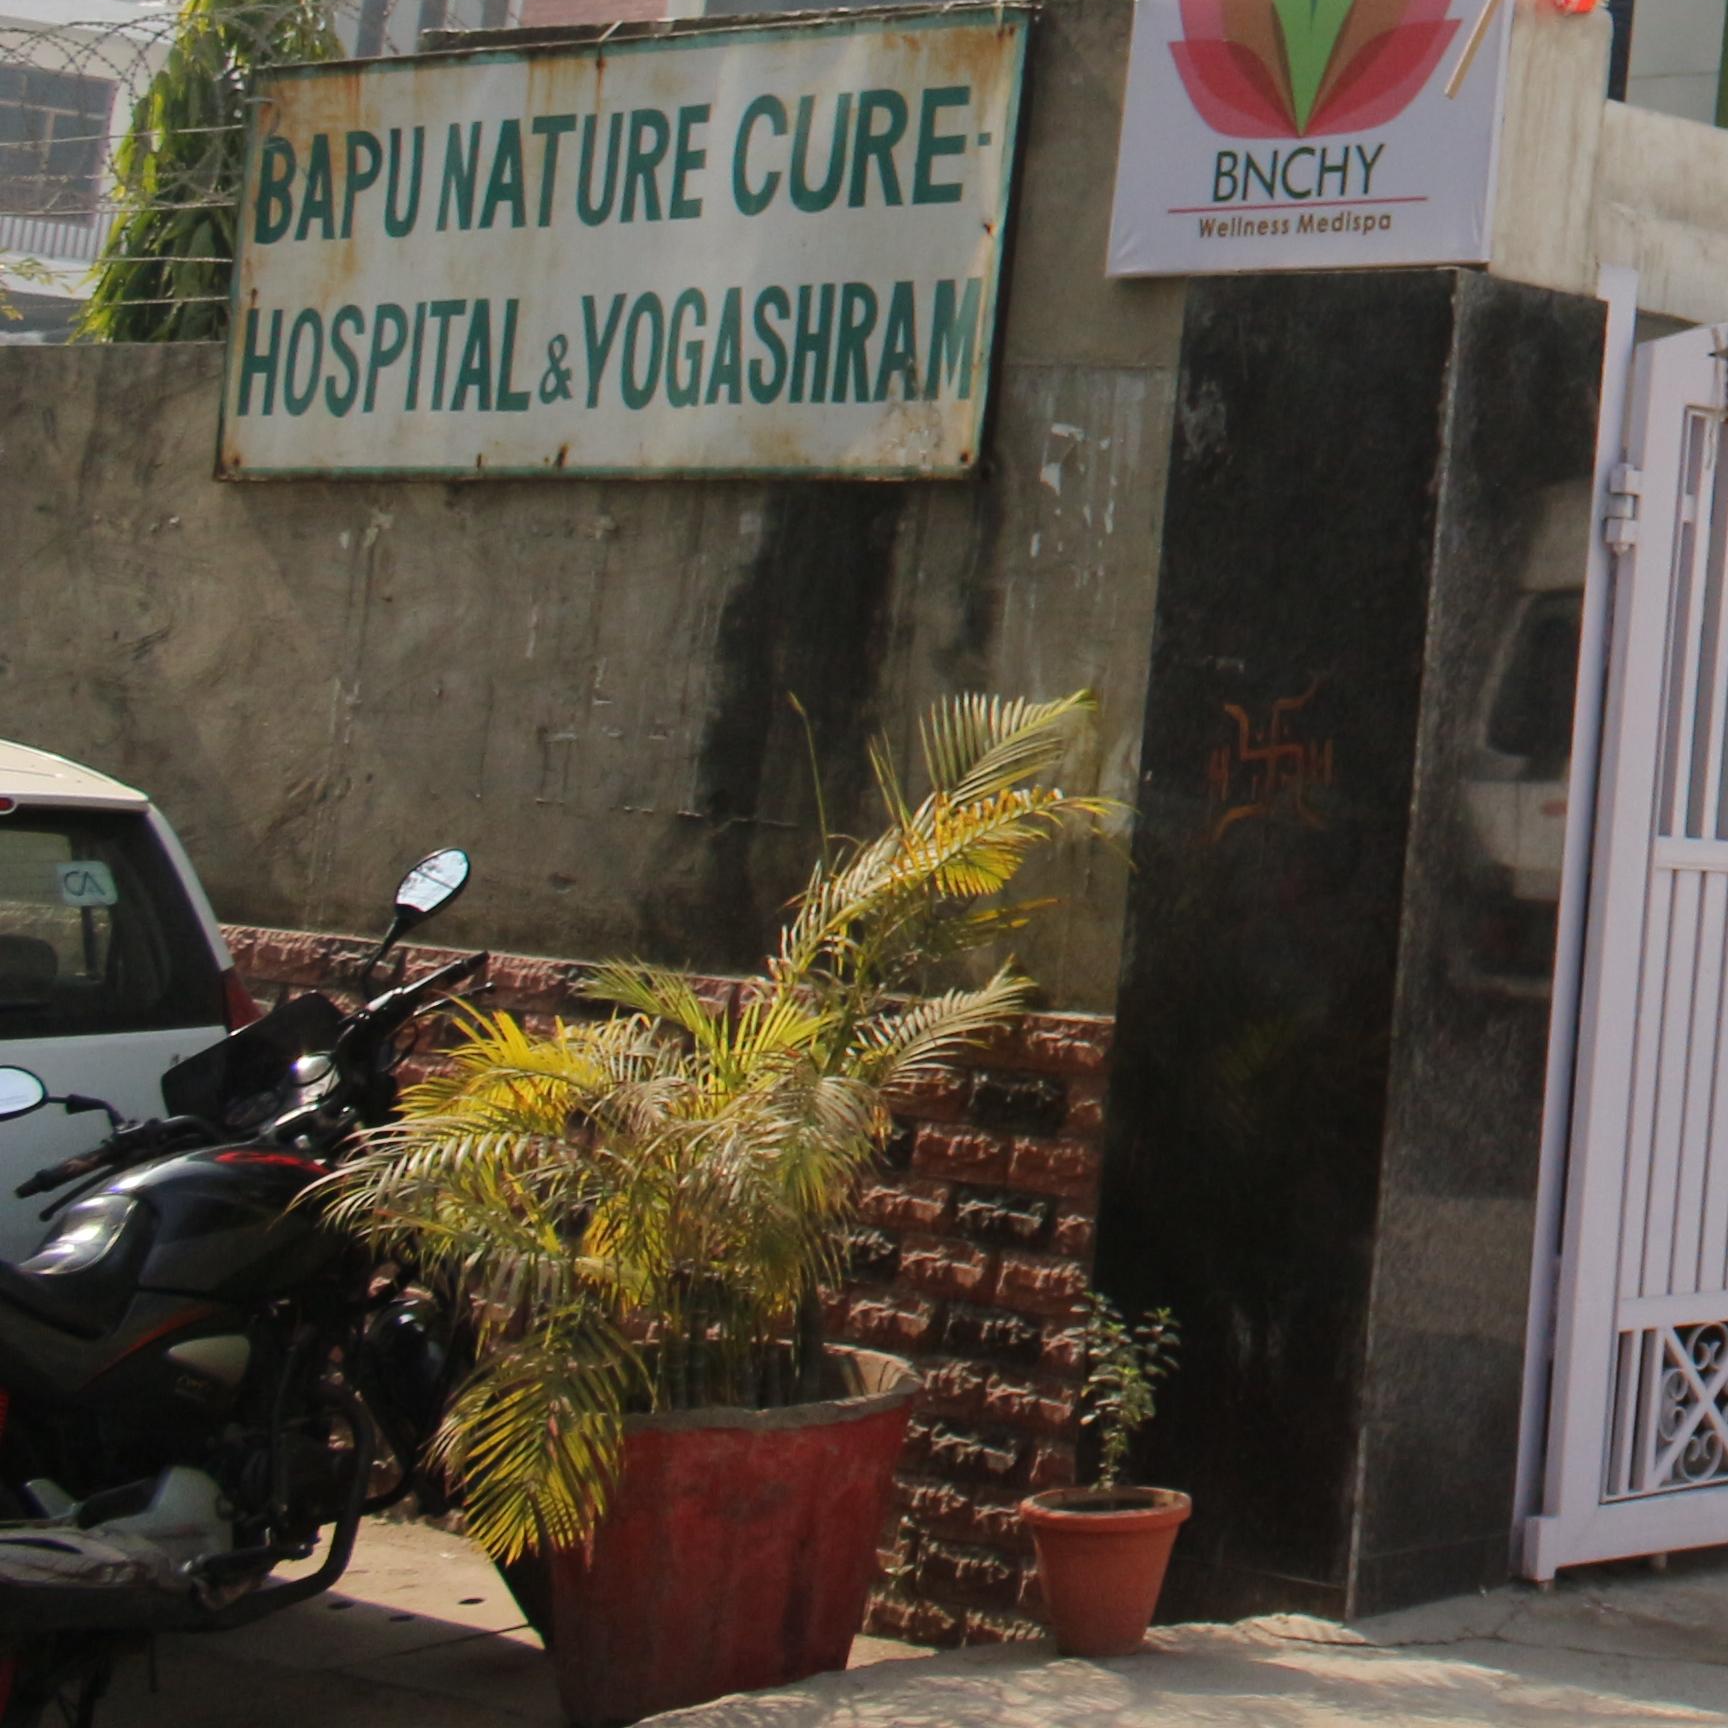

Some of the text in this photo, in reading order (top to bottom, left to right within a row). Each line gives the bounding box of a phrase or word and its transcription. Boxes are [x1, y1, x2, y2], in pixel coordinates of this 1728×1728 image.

[254, 125, 426, 245] BAPU
[436, 102, 712, 232] NATURE
[1212, 143, 1386, 202] BNCHY
[1199, 211, 1393, 239] Wellness Medispa
[236, 277, 983, 418] HOSPITAL & YOGASHRAM
